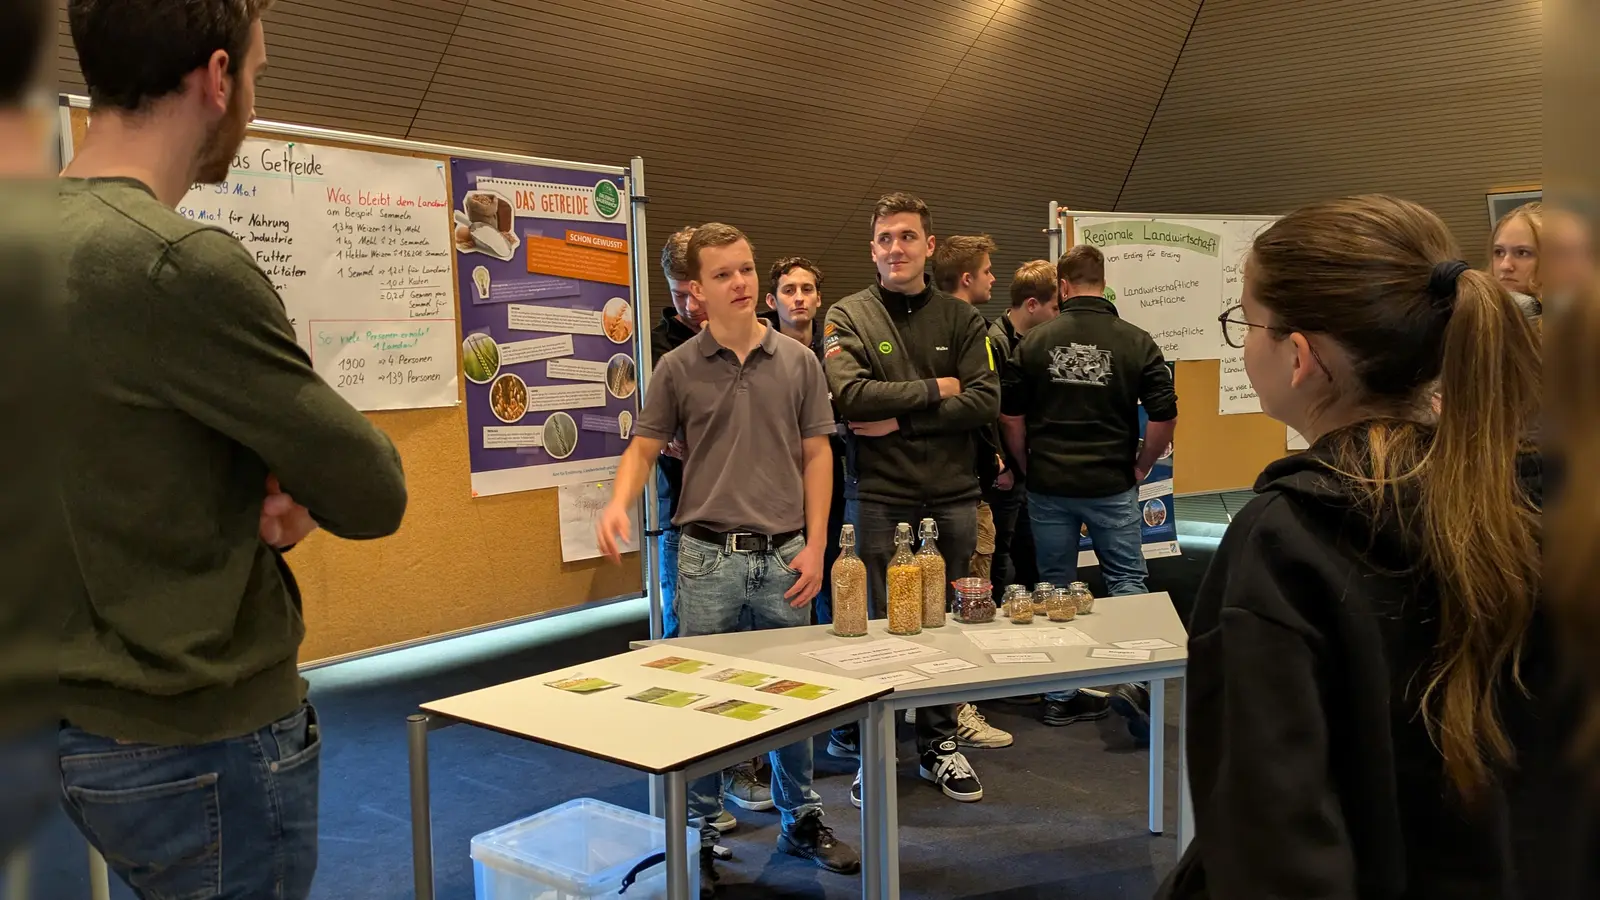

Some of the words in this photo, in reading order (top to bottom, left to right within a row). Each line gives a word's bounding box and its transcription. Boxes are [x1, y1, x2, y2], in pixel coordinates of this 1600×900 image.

[231, 154, 250, 169] as
[261, 148, 324, 176] Getreide
[326, 186, 351, 205] Was
[358, 189, 390, 206] bleibt
[396, 196, 415, 208] dem
[515, 190, 535, 212] DAS
[541, 193, 589, 216] GETREIDE
[228, 210, 244, 225] für
[248, 213, 290, 233] Nahrung
[326, 209, 340, 217] am
[344, 206, 374, 220] Beispiel
[356, 223, 380, 233] Weizen
[248, 231, 293, 245] Industrie
[357, 236, 377, 245] Mehl
[569, 233, 592, 245] SCHON
[592, 237, 623, 249] GEWUSST?
[1083, 229, 1134, 247] Regionale
[1143, 225, 1217, 252] Landwirtschaft
[256, 250, 293, 263] Futter
[1107, 255, 1120, 263] von
[1123, 252, 1143, 262] Erding
[1146, 249, 1156, 259] für
[1160, 250, 1181, 262] Erding
[1123, 279, 1200, 297] Landwirtschaftliche
[338, 358, 366, 371] 1900
[388, 356, 394, 366] 4
[398, 354, 433, 365] Personen
[337, 373, 365, 388] 2024
[386, 371, 404, 385] 139
[407, 370, 441, 384] Personen
